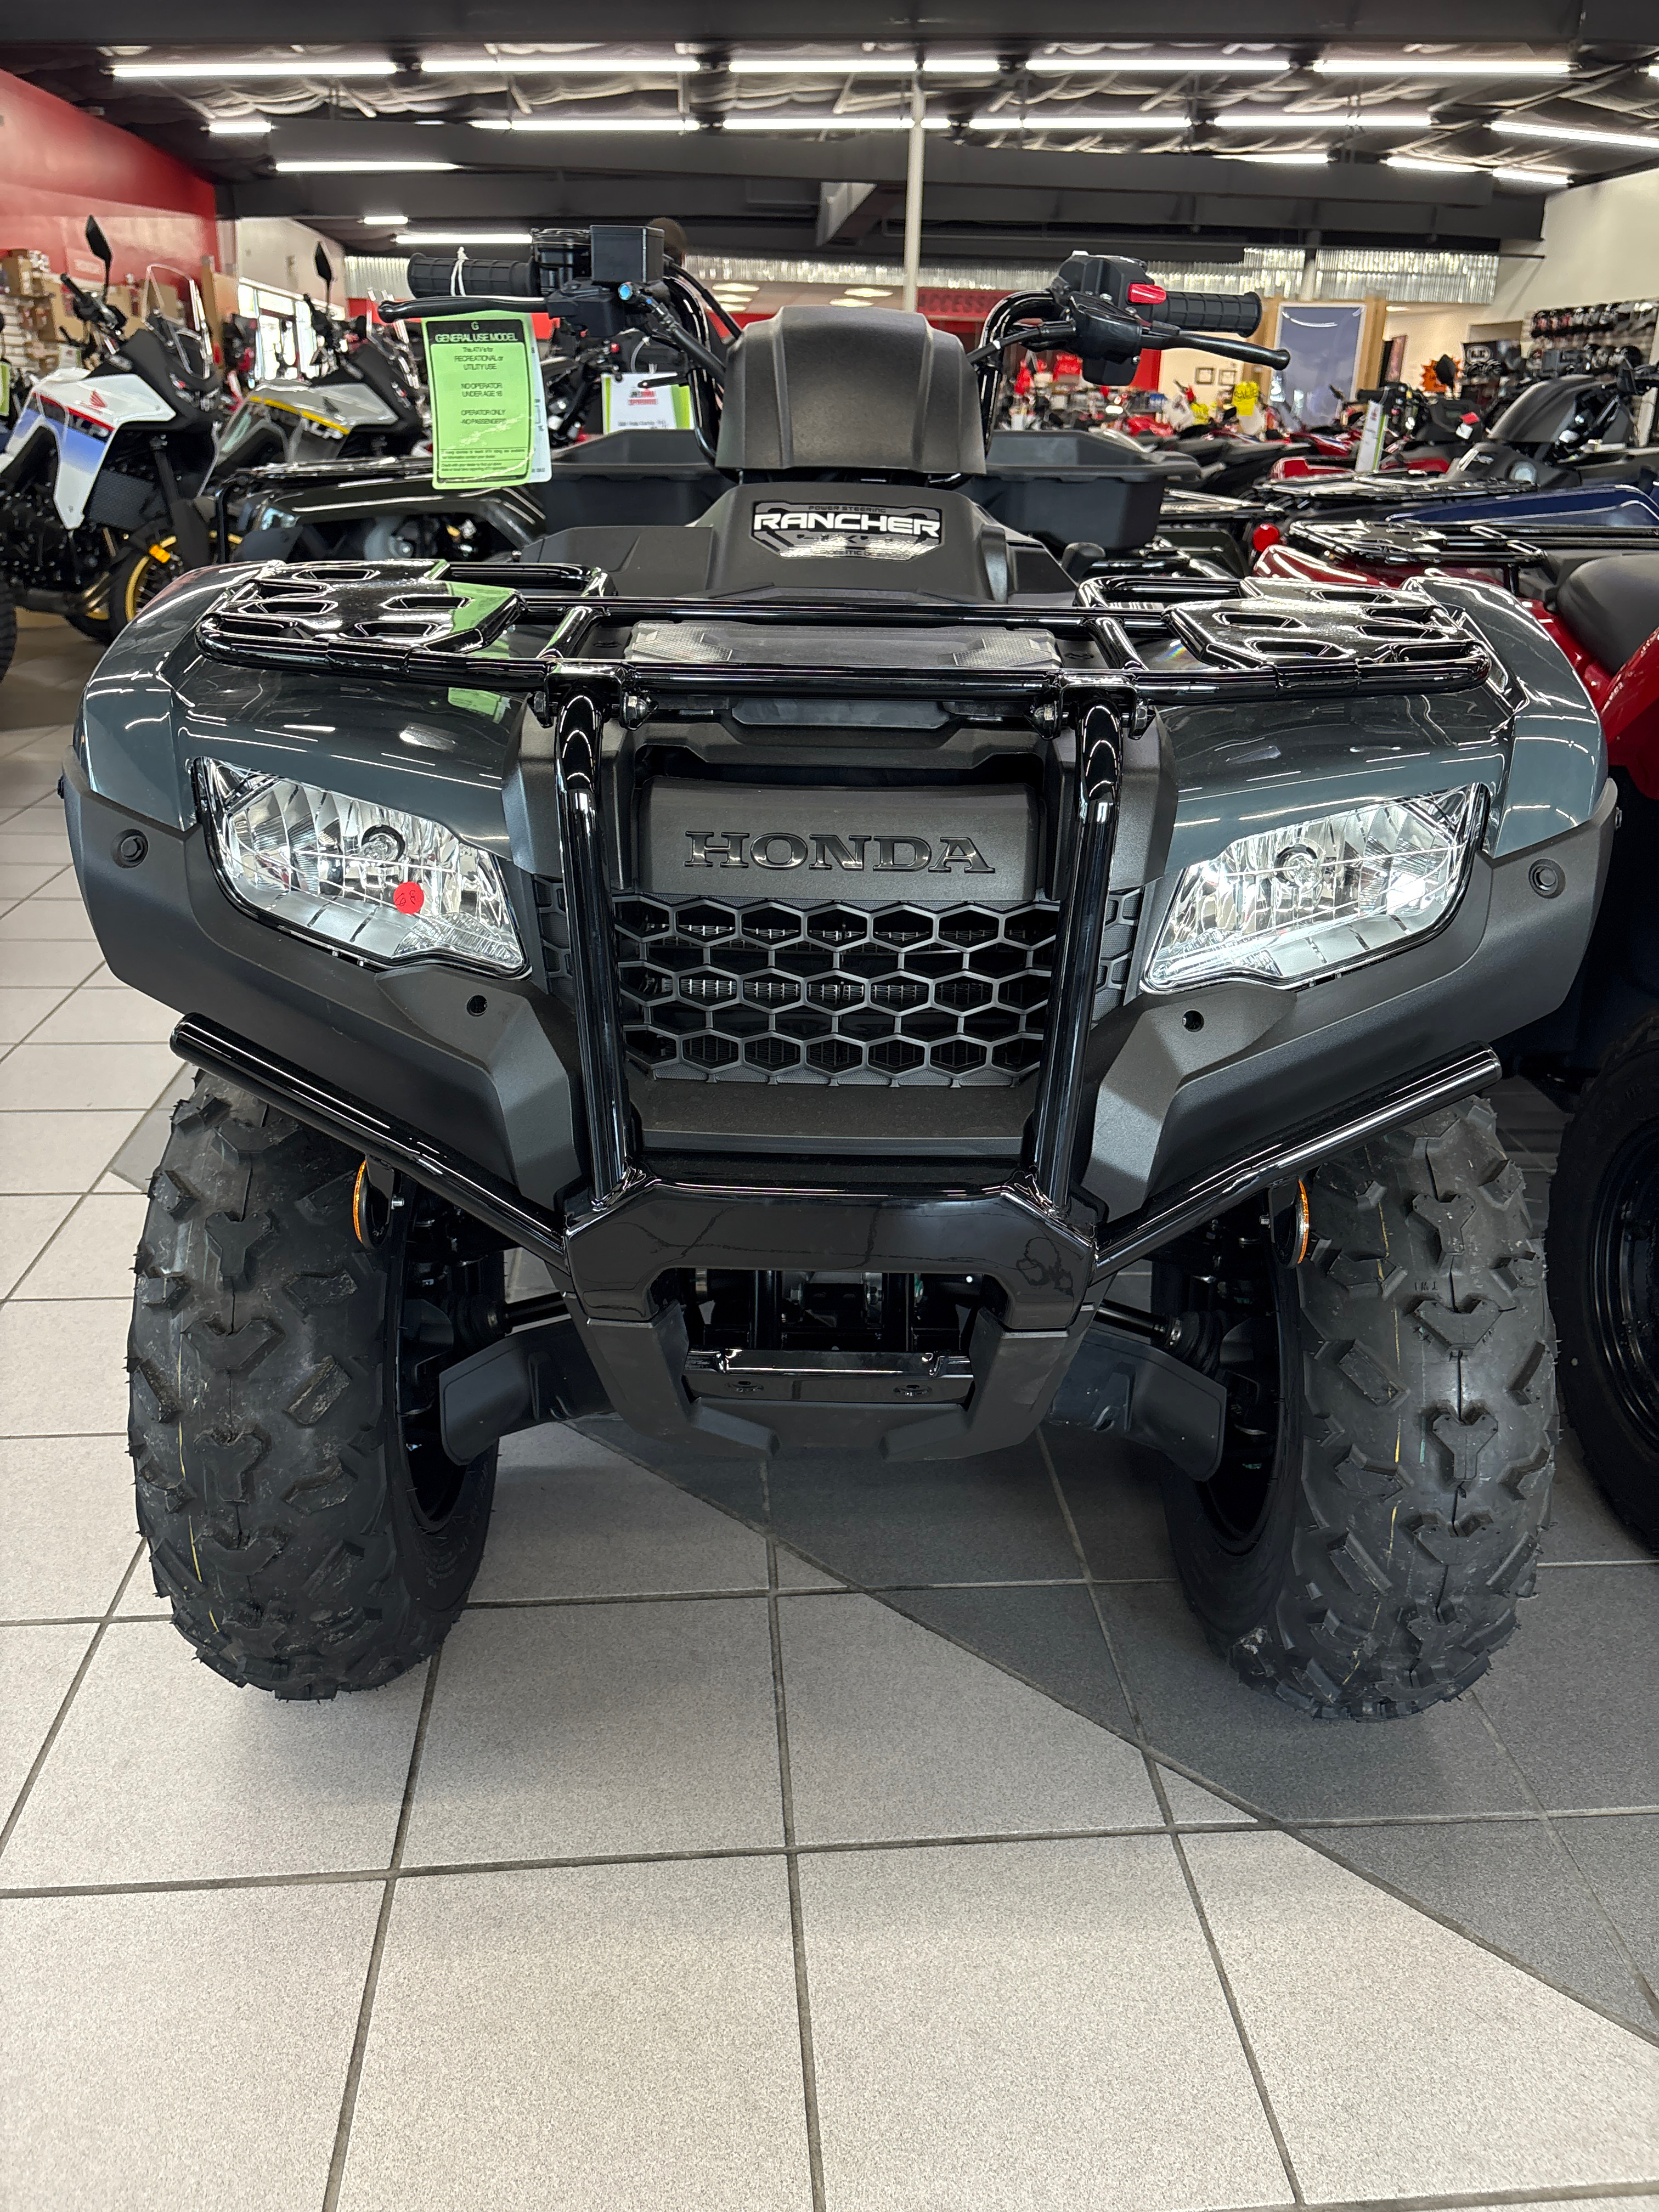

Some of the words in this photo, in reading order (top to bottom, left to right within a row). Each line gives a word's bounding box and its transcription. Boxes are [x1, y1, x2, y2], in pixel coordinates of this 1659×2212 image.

[471, 321, 480, 331] G
[435, 333, 473, 343] GENERAL
[473, 333, 489, 342] USE
[489, 332, 518, 342] MODEL
[753, 512, 941, 538] RANCHER
[684, 831, 996, 873] HONDA
